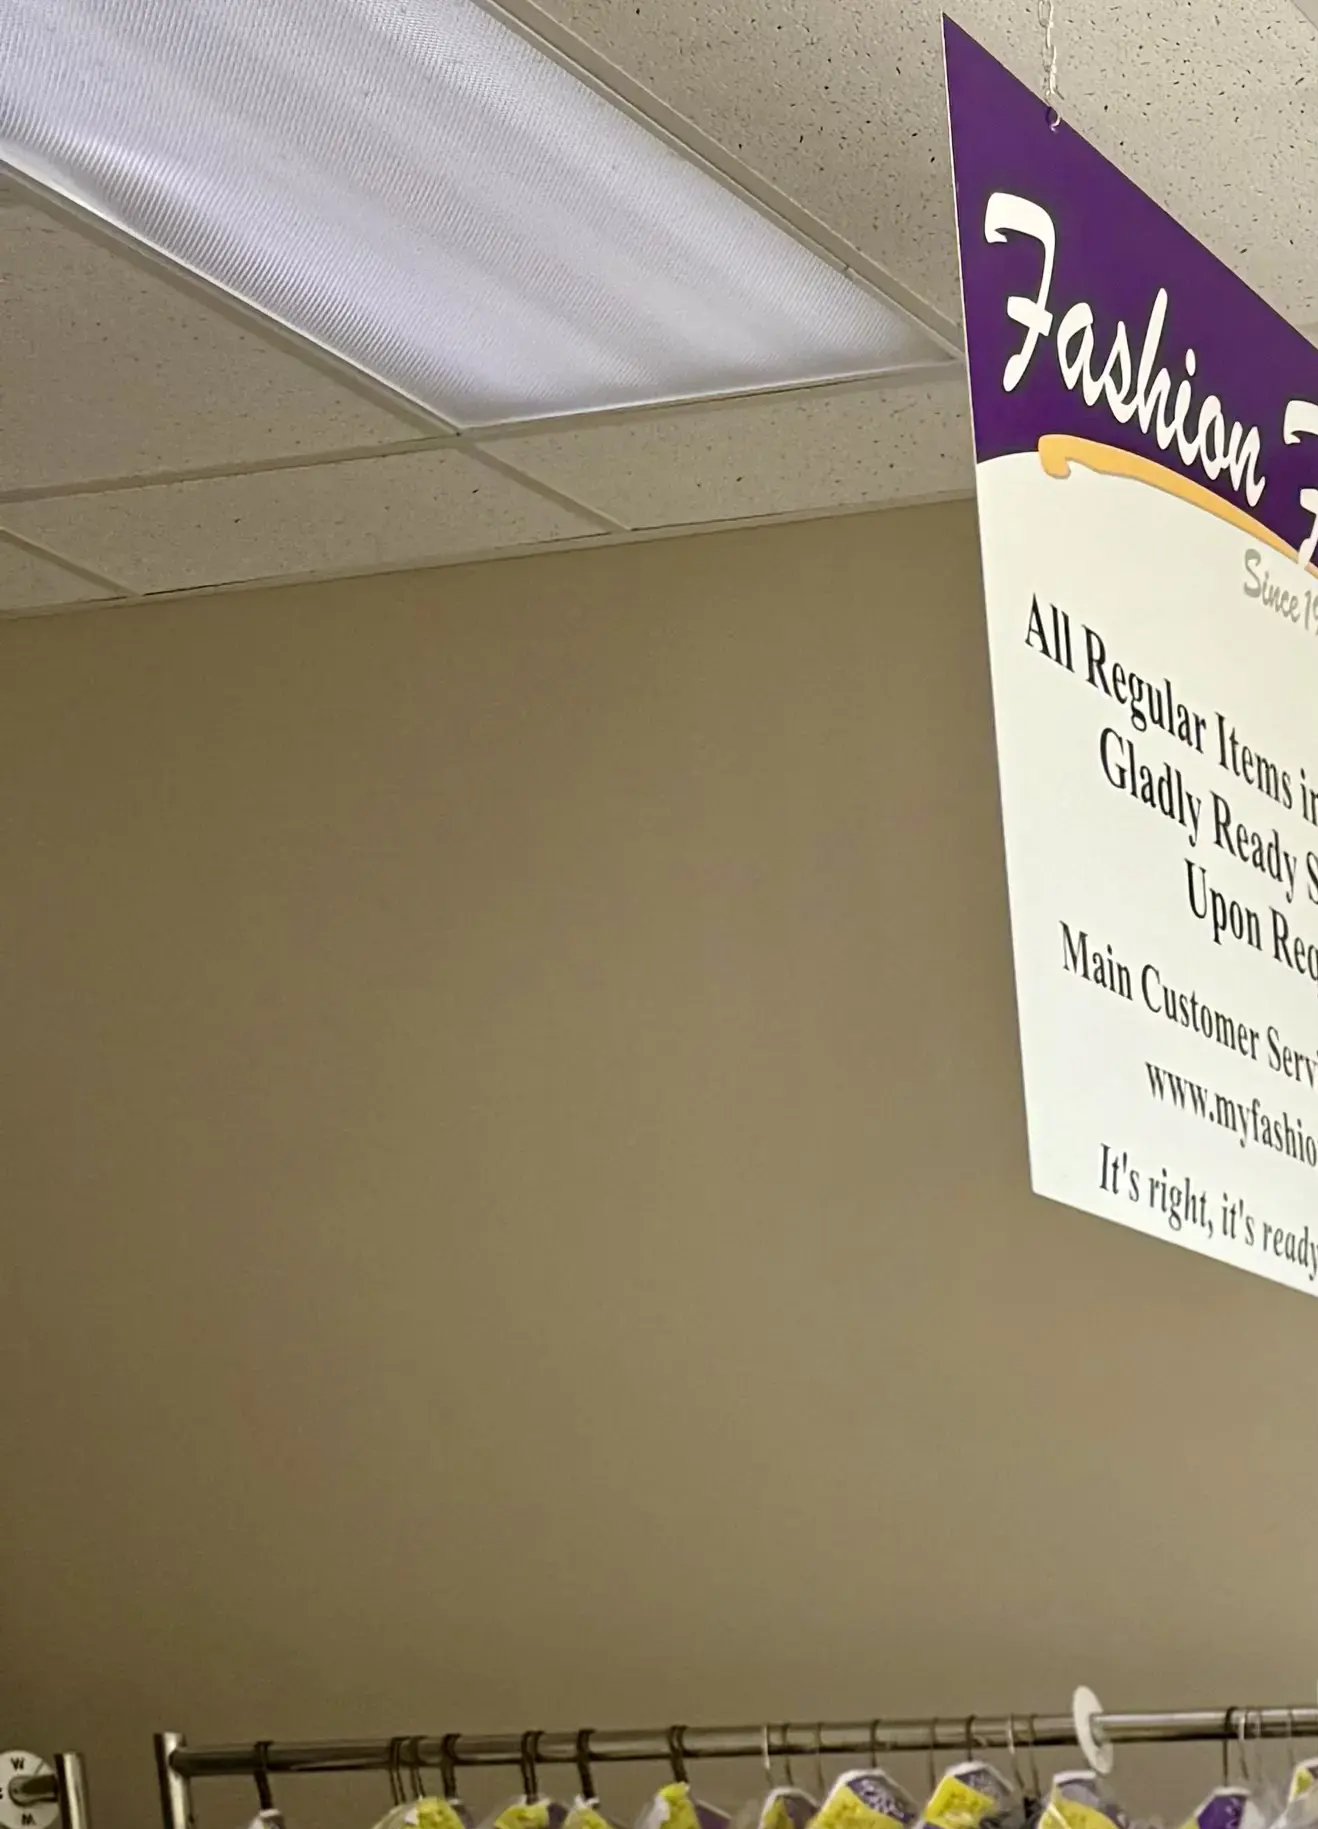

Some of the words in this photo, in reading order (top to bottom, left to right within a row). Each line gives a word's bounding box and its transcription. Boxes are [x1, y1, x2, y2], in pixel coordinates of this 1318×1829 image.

[983, 192, 1266, 506] Fashion
[1243, 548, 1300, 624] Since
[1024, 592, 1075, 674] All
[1083, 623, 1206, 753] Regular
[1215, 711, 1293, 810] Items
[1100, 728, 1202, 847] Gladly
[1211, 791, 1298, 904] Ready
[1185, 860, 1263, 952] Upon
[1059, 921, 1134, 1002] Main
[1142, 964, 1260, 1062] Customer
[1099, 1143, 1140, 1203] It's
[1148, 1168, 1215, 1240] right,
[1221, 1193, 1256, 1247] it's
